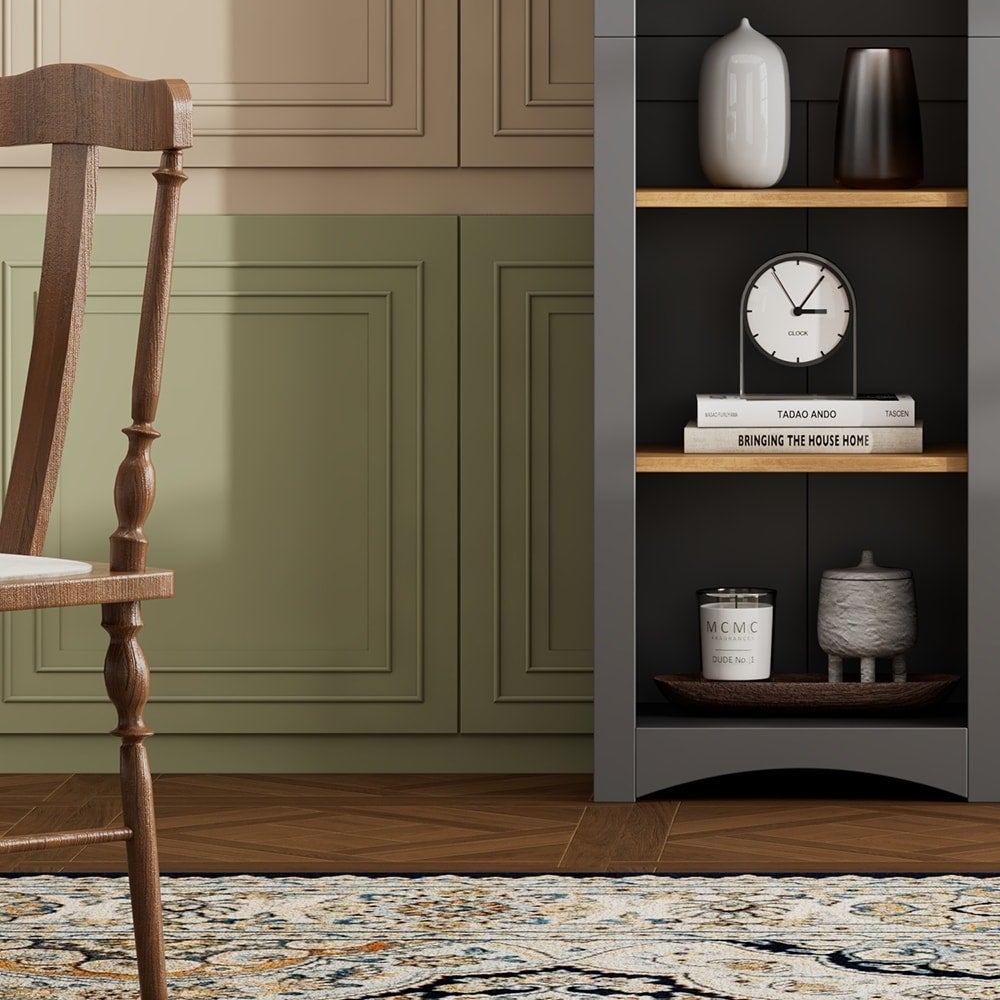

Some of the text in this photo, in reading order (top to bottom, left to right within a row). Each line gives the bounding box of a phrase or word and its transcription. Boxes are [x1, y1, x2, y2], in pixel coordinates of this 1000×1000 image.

[777, 410, 837, 419] TADAO ANDO
[885, 410, 909, 418] TASCEN
[738, 435, 870, 446] BRINGING THE HOUSE HOME
[712, 655, 733, 664] DUDE
